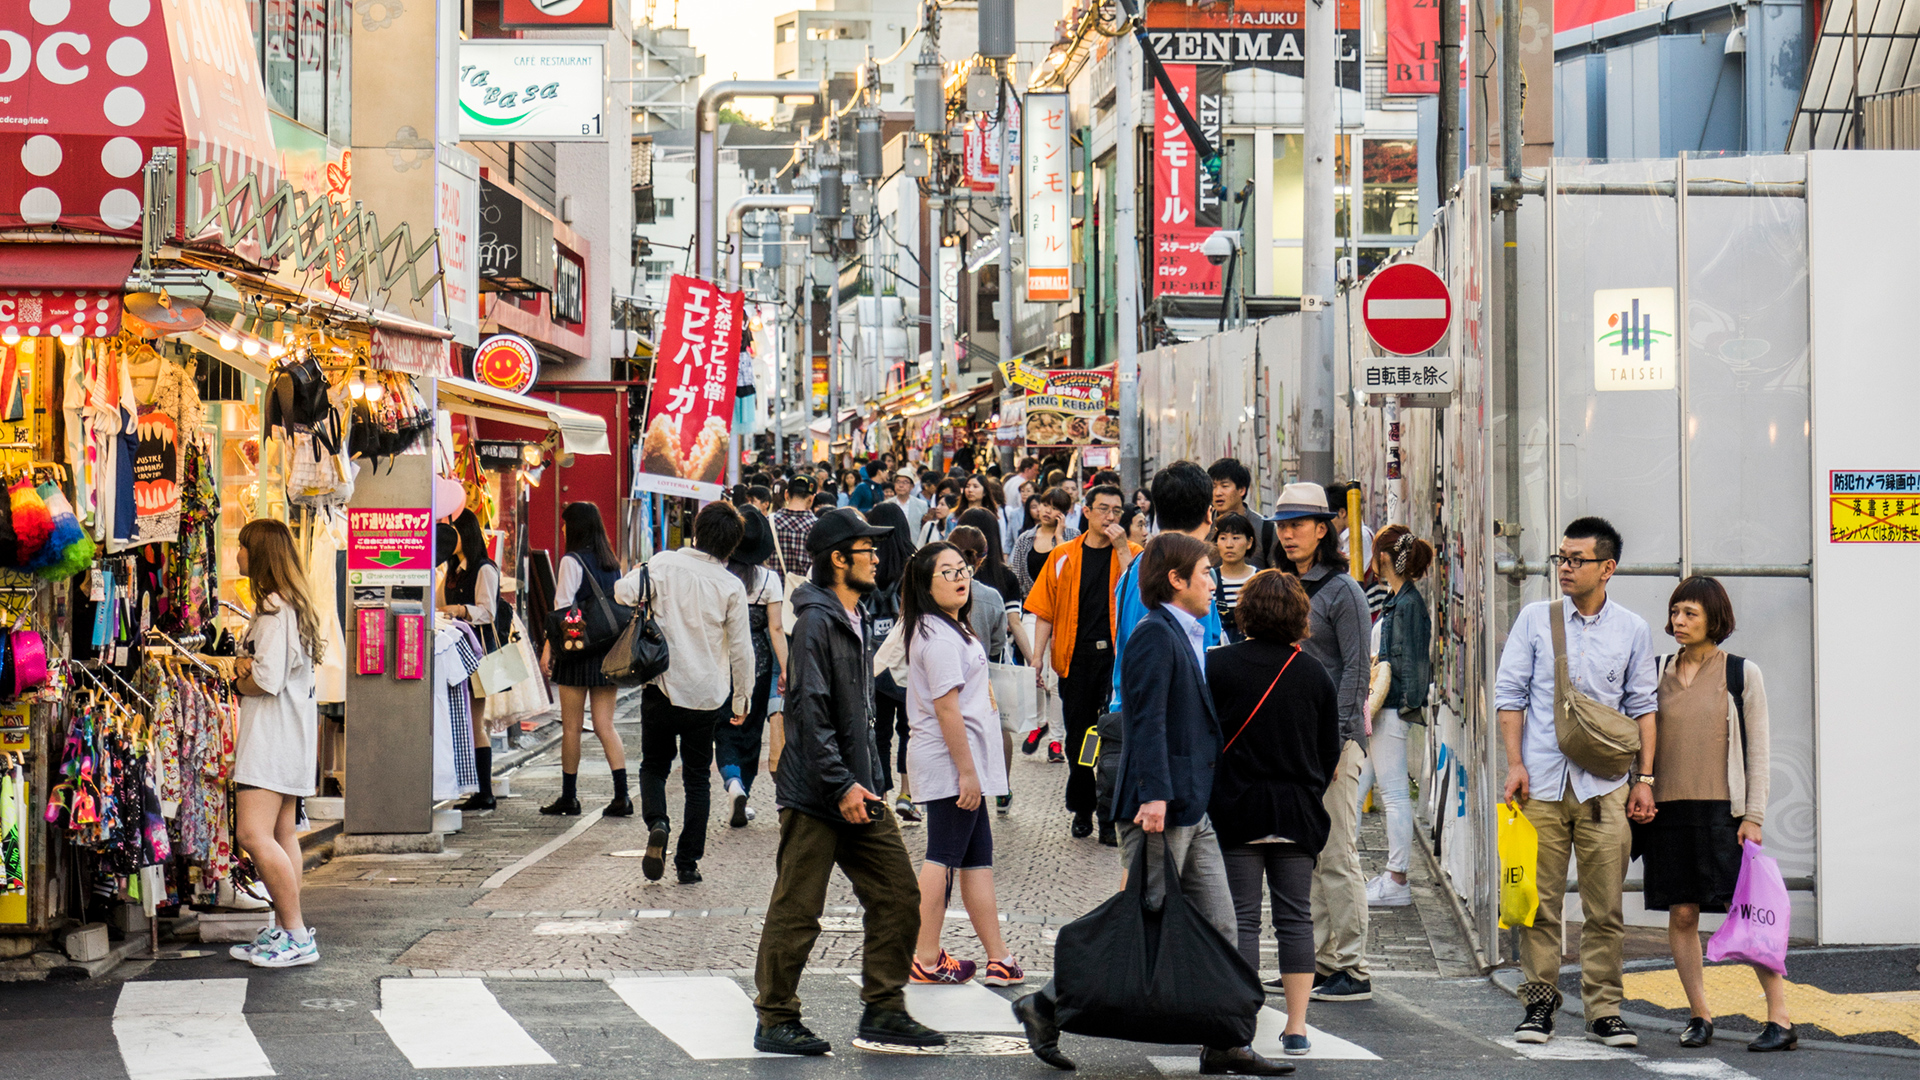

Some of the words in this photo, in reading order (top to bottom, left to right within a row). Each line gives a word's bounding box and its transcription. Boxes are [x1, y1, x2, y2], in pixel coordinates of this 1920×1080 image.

[1149, 32, 1356, 62] ZENMAL
[540, 57, 592, 66] RESTAURANT
[1200, 94, 1220, 212] ZENALL
[1041, 109, 1065, 253] ゼンモール
[442, 182, 460, 227] BRAND
[1159, 265, 1188, 276] ロック
[1029, 275, 1068, 290] ZENMALL
[665, 286, 710, 435] エビバーガー
[1366, 366, 1448, 386] 自転車を除く
[1611, 367, 1662, 381] TAISEI
[1028, 396, 1058, 407] KING
[1062, 398, 1104, 410] KEBAB
[657, 480, 689, 489] LOTTERIA
[1853, 498, 1919, 516] 落書き禁止
[350, 512, 430, 530] 竹下通り公式マップ
[352, 530, 387, 538] TAKESHITA
[388, 530, 413, 538] STREET
[414, 530, 428, 538] MAP
[9, 847, 20, 870] ONLY
[1741, 904, 1776, 926] WEGO
